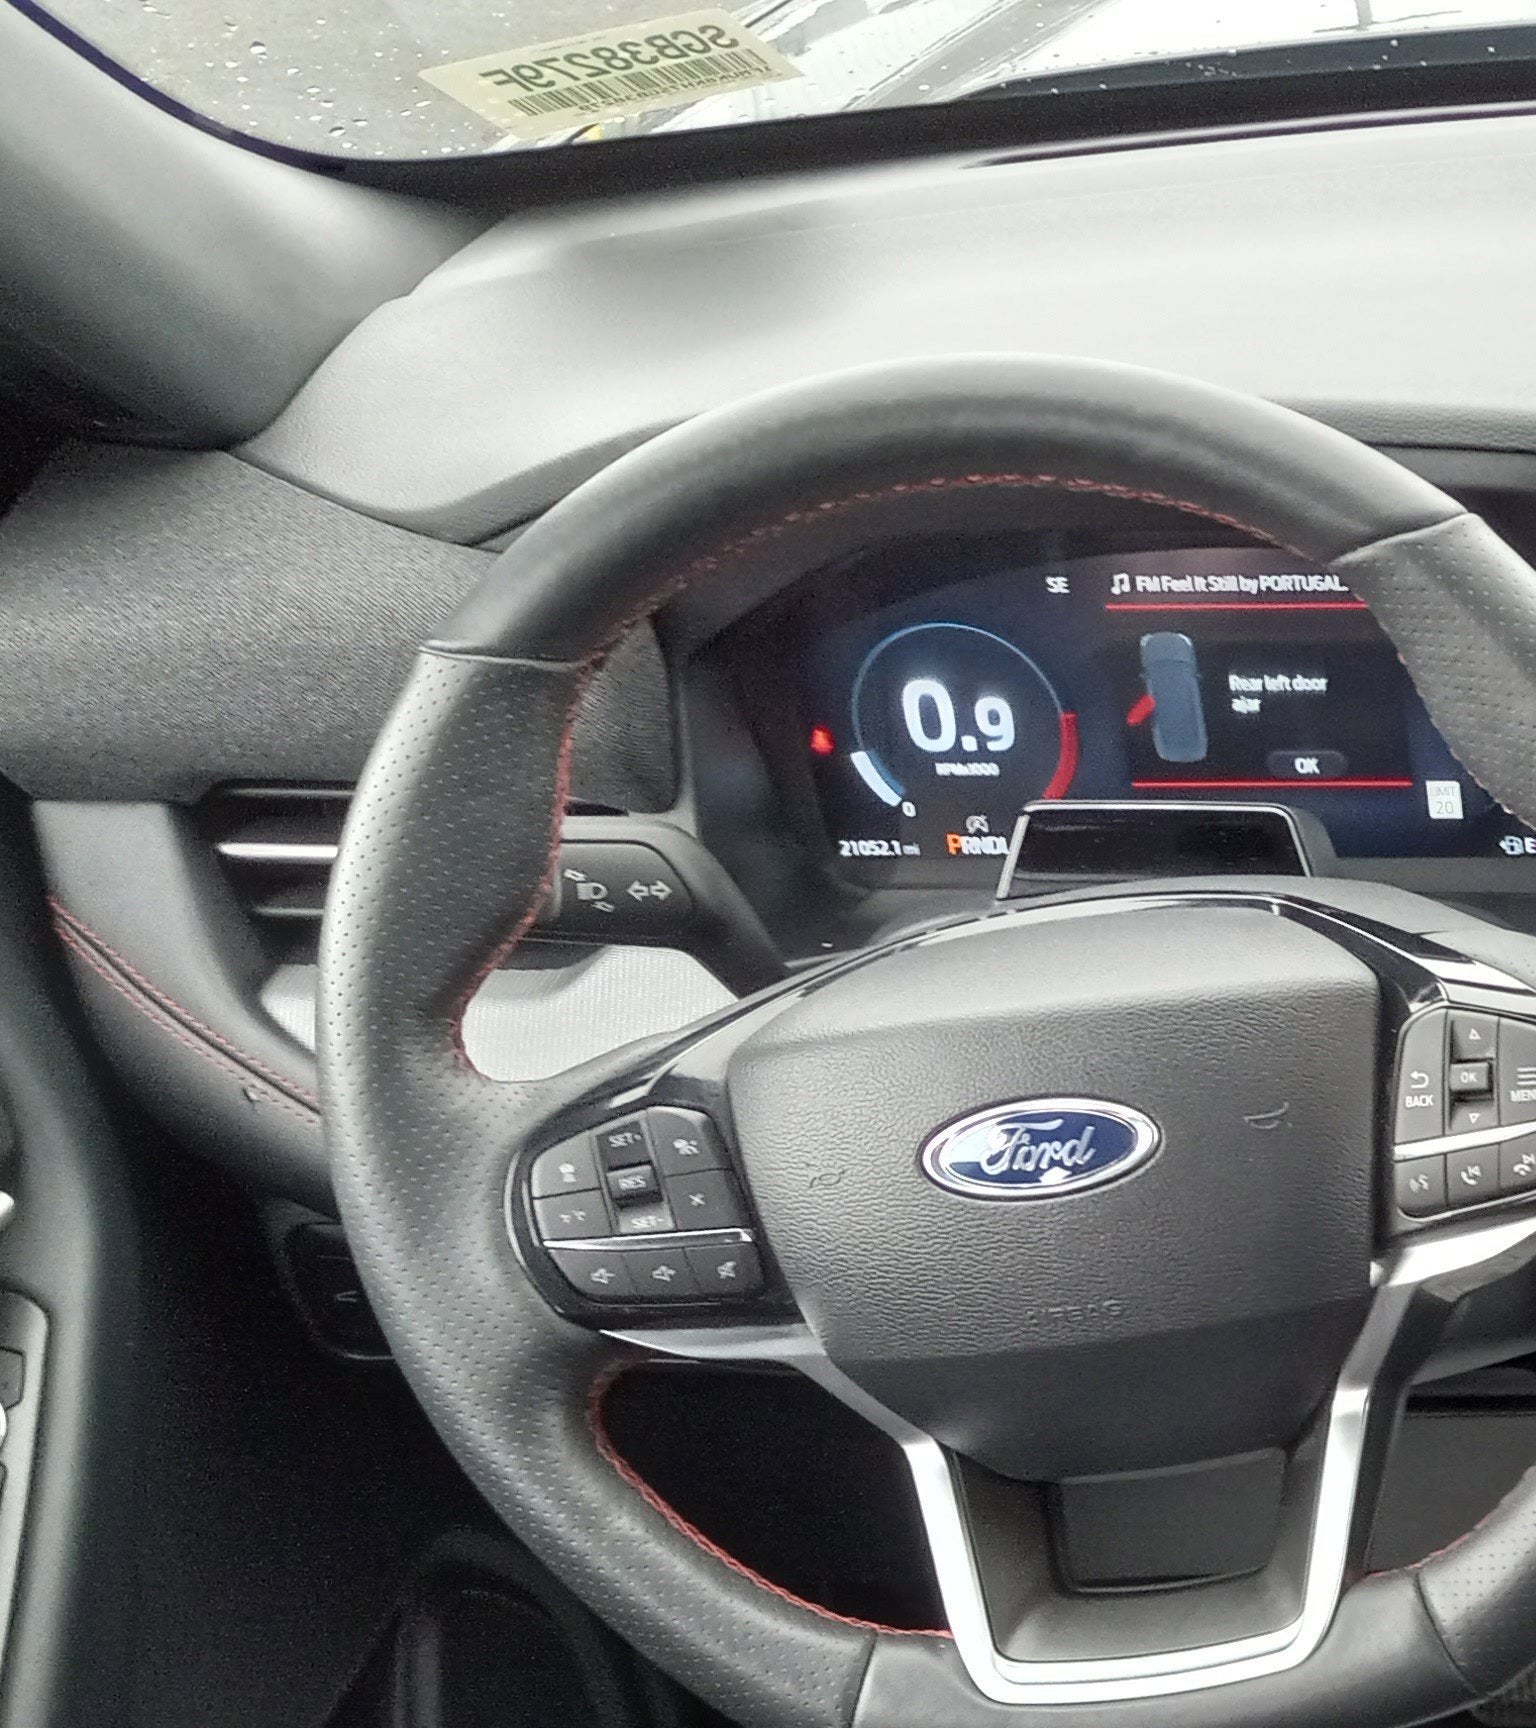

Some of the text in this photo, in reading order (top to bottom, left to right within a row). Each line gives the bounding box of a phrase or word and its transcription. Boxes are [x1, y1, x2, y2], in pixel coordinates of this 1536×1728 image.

[1045, 576, 1070, 593] SE
[1162, 575, 1194, 592] Feel
[1209, 575, 1239, 592] Still
[1239, 575, 1259, 595] by
[1228, 674, 1329, 692] Rear left door
[902, 678, 1015, 753] 0.9
[1294, 757, 1320, 775] OK
[902, 801, 917, 817] 0
[1436, 801, 1454, 815] 20
[1461, 1072, 1477, 1083] OK
[1405, 1095, 1434, 1108] BACK
[980, 1118, 1098, 1176] Ford
